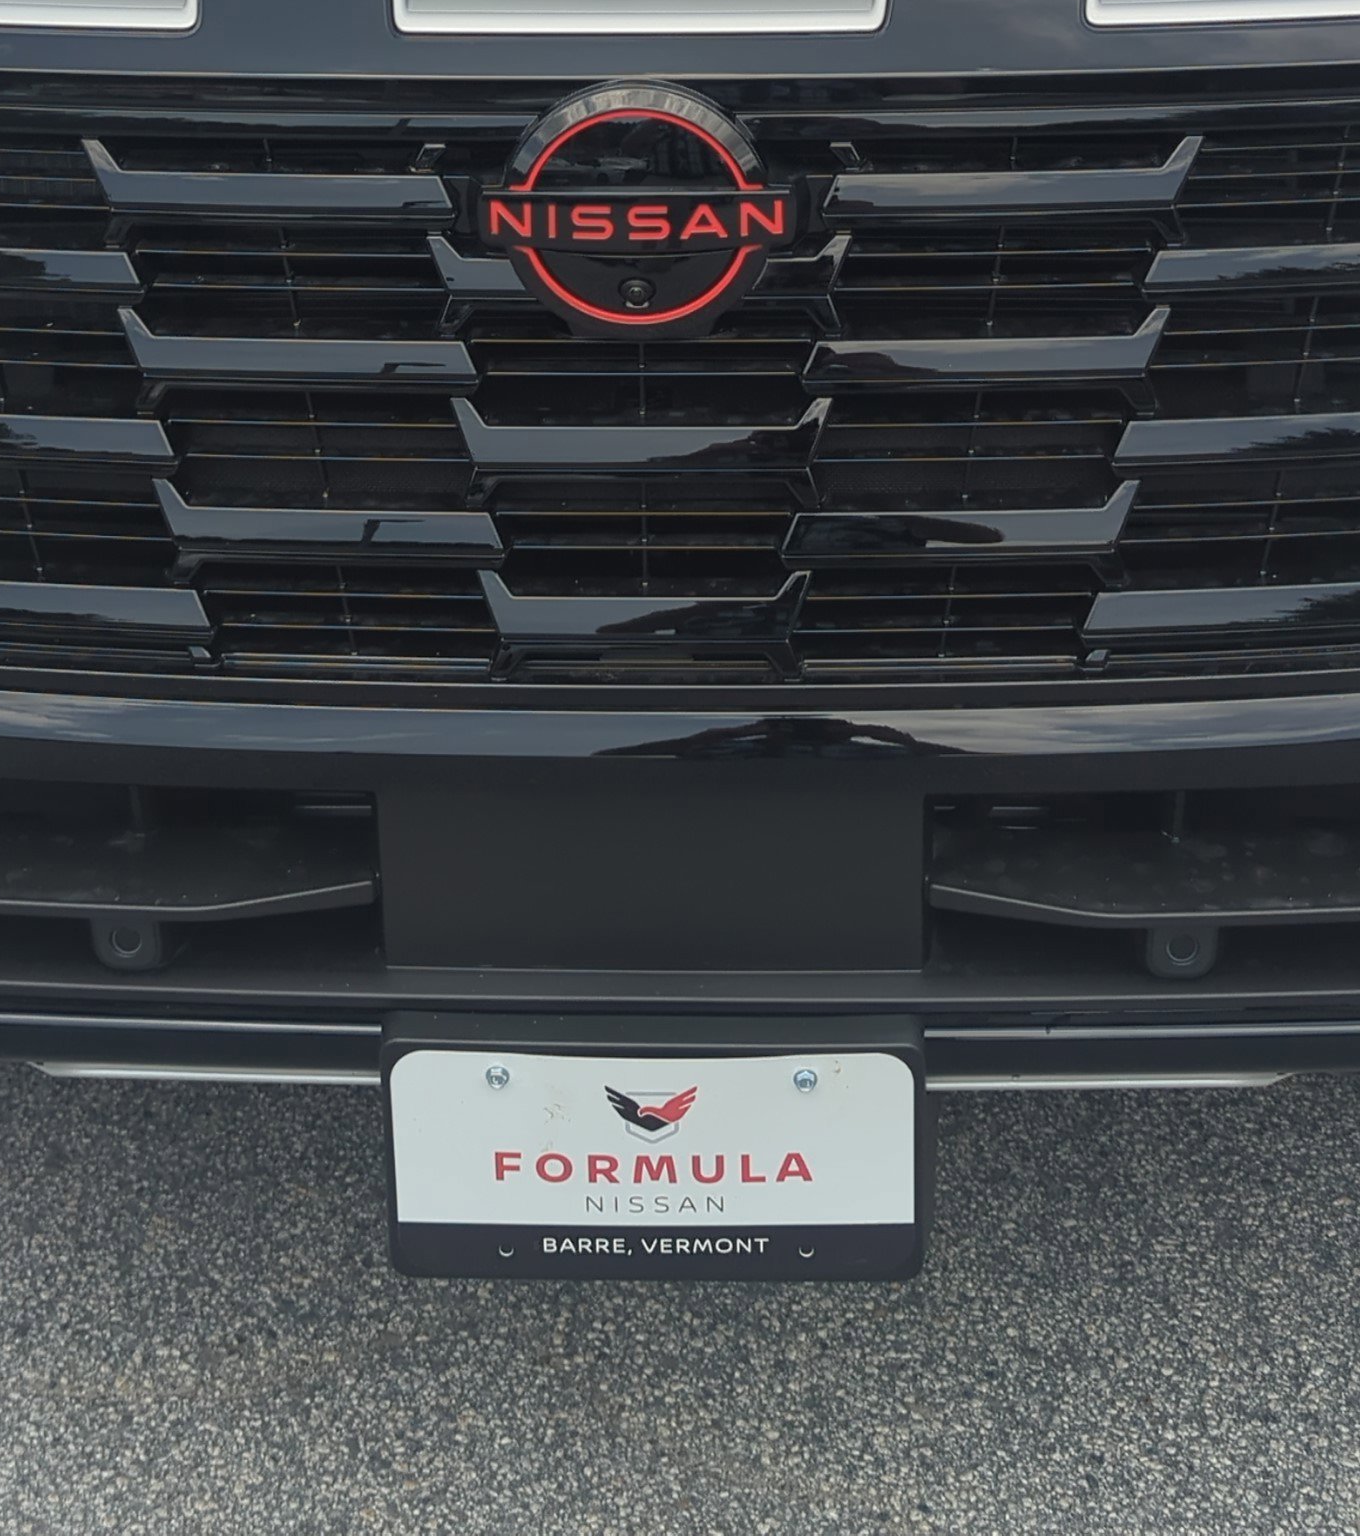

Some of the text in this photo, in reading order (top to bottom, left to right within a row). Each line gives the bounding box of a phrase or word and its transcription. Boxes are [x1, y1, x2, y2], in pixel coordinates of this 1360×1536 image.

[489, 200, 784, 241] NISSAN
[493, 1151, 814, 1184] FORMULA
[585, 1195, 726, 1214] NISSAN
[542, 1237, 770, 1256] BARRE, VERMONT
